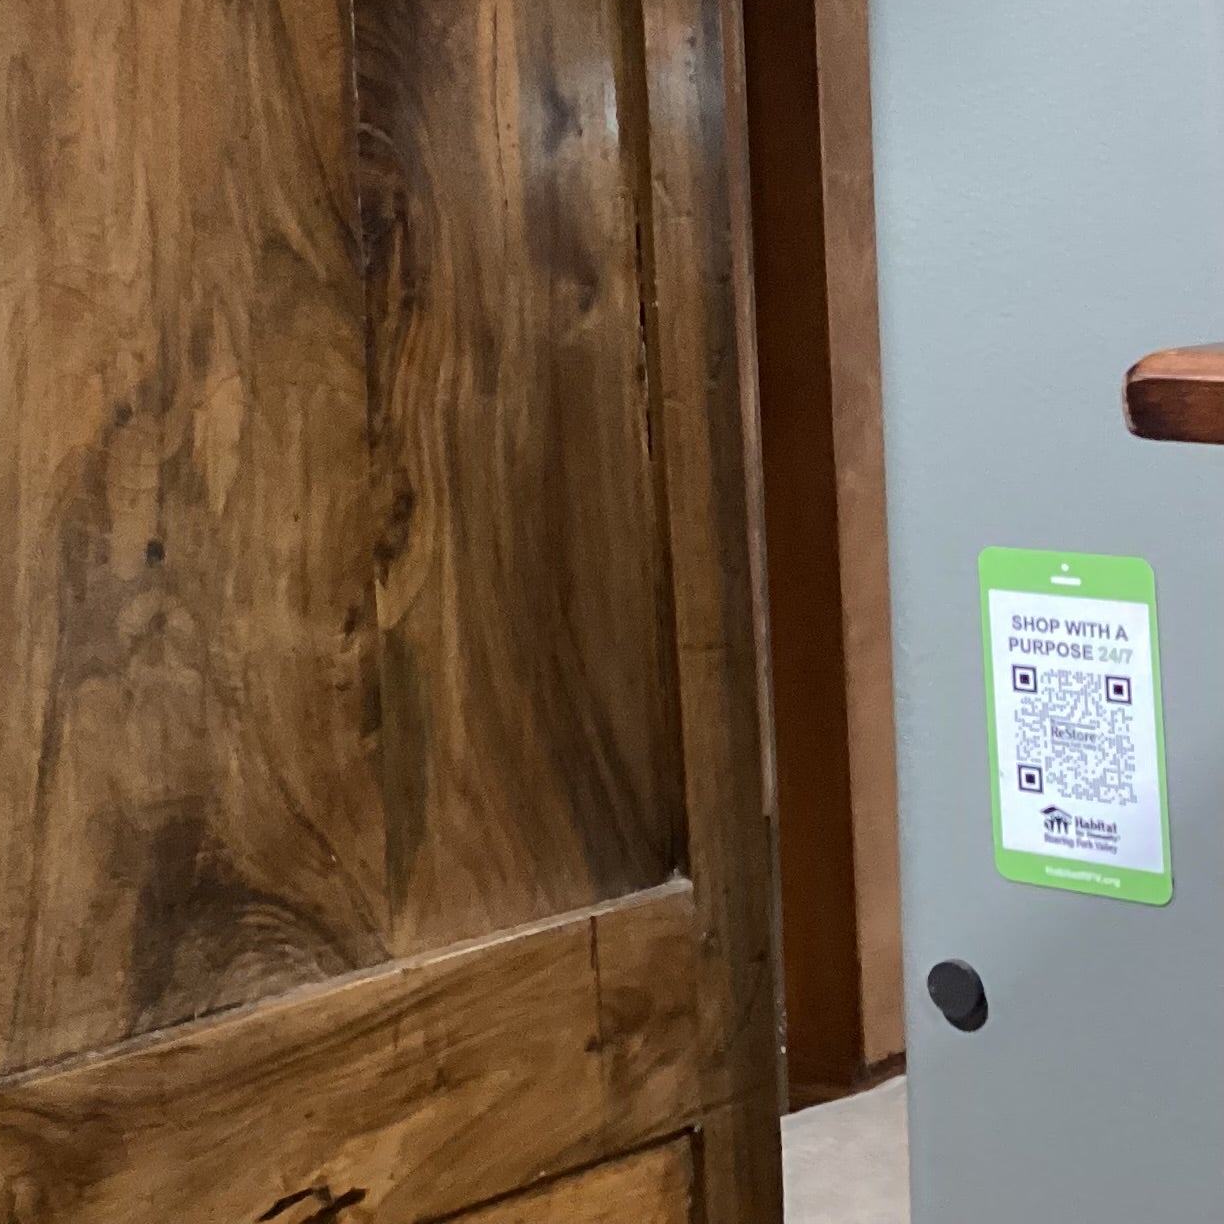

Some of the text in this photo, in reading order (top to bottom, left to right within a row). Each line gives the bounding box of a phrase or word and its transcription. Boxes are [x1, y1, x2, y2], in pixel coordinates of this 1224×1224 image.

[1011, 614, 1128, 642] SHOP WITH A
[1008, 636, 1134, 665] PURPOSE 24/7
[1050, 725, 1097, 743] ReStore
